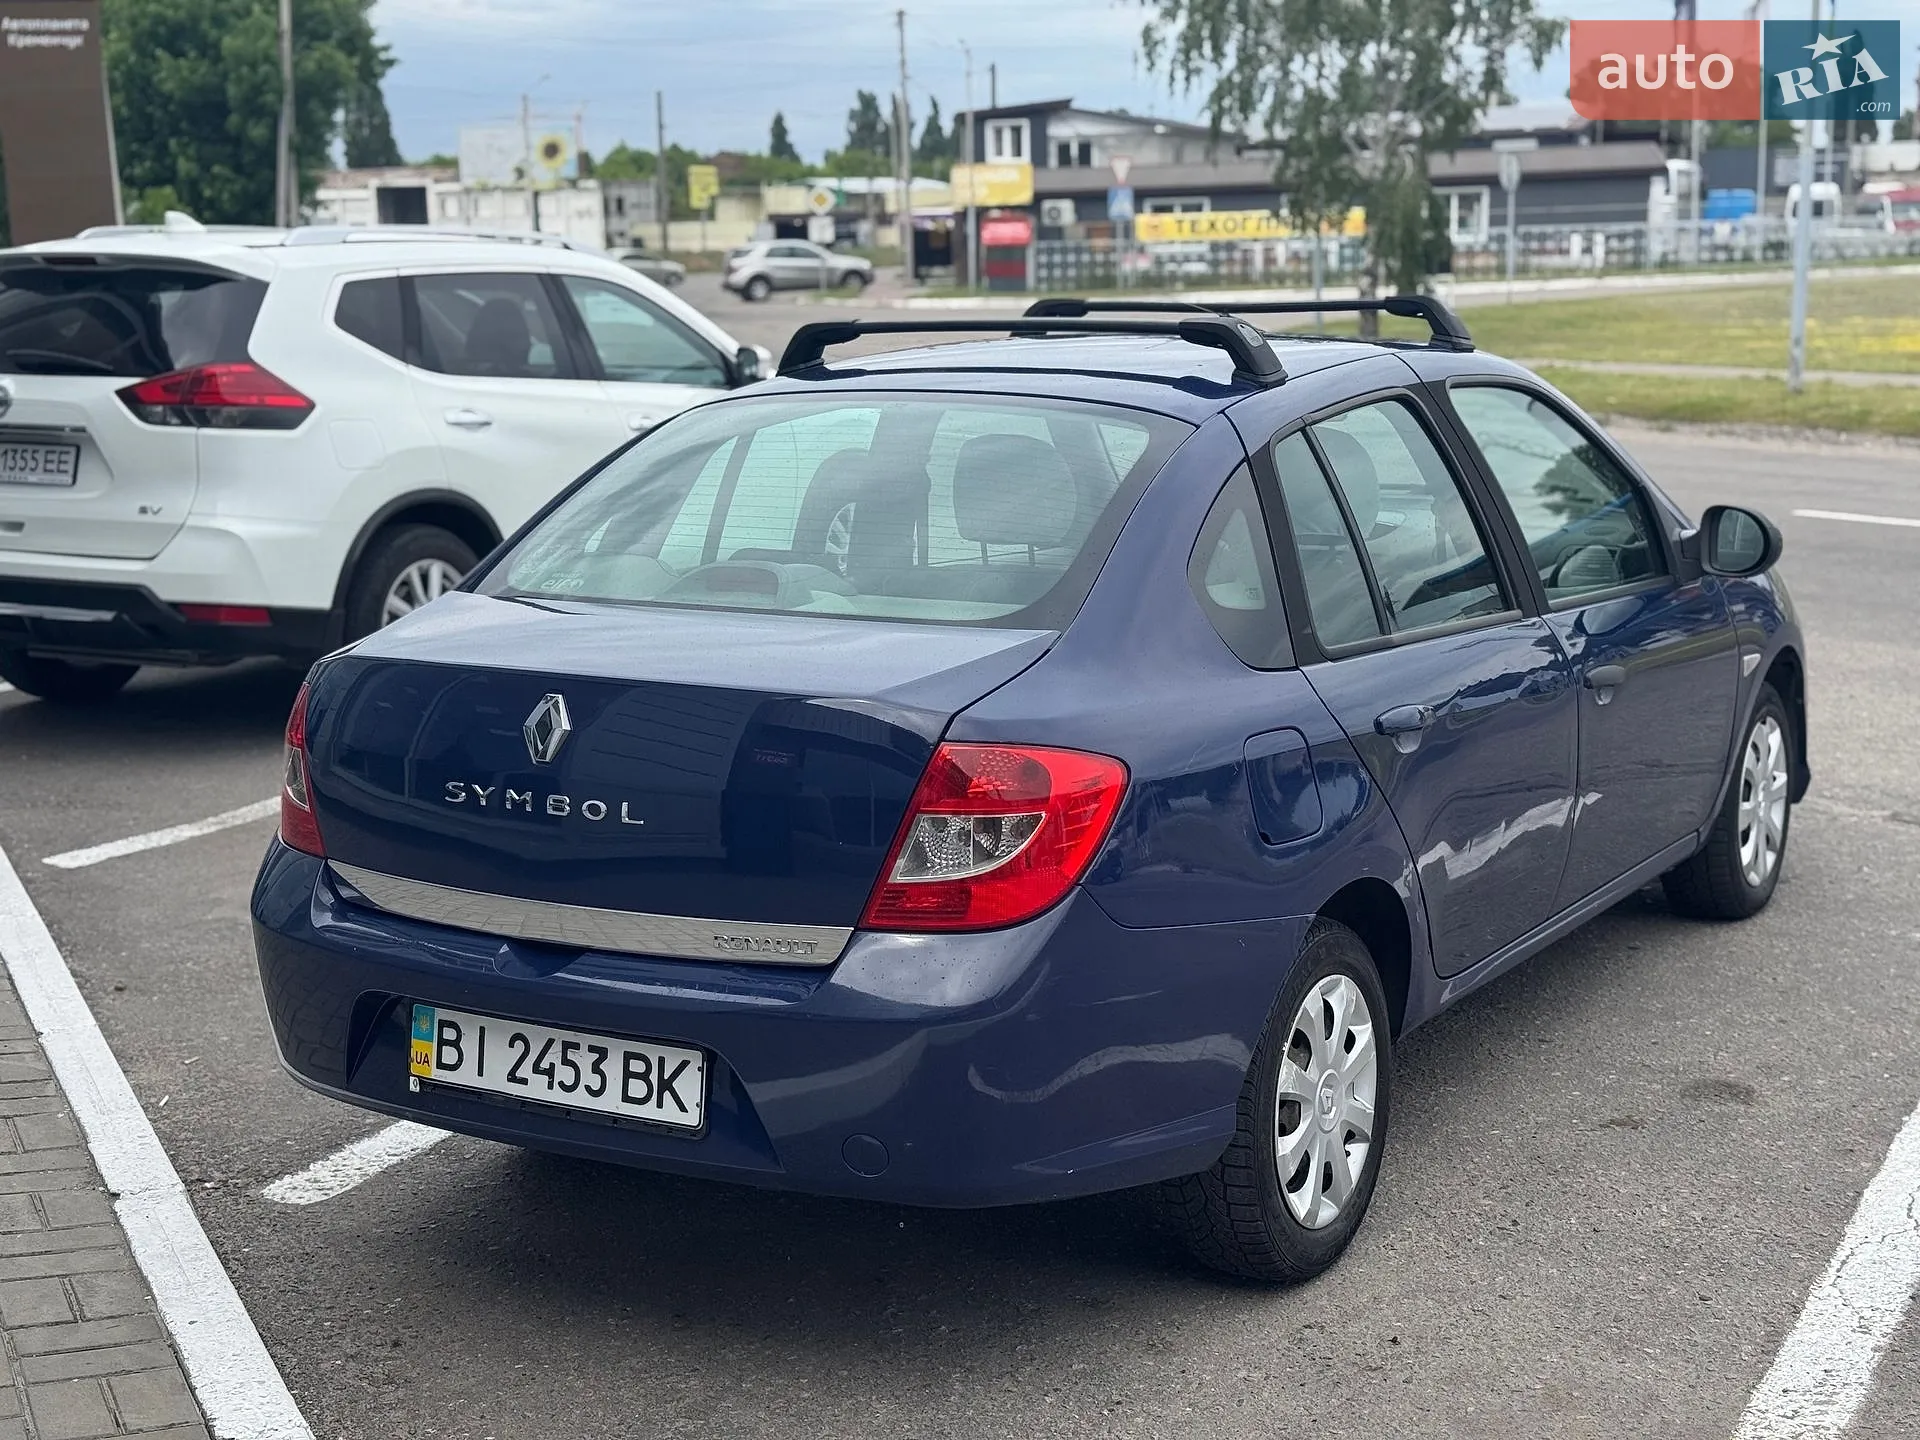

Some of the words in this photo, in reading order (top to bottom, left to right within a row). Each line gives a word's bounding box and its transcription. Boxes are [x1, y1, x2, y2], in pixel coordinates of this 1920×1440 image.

[0, 449, 39, 473] 1355
[43, 450, 71, 474] EE
[444, 781, 644, 825] SYMBOL
[712, 935, 818, 955] RENAULT
[414, 1050, 431, 1068] UA
[435, 1018, 486, 1078] BI
[506, 1032, 609, 1098] 2453
[620, 1050, 691, 1113] BK
